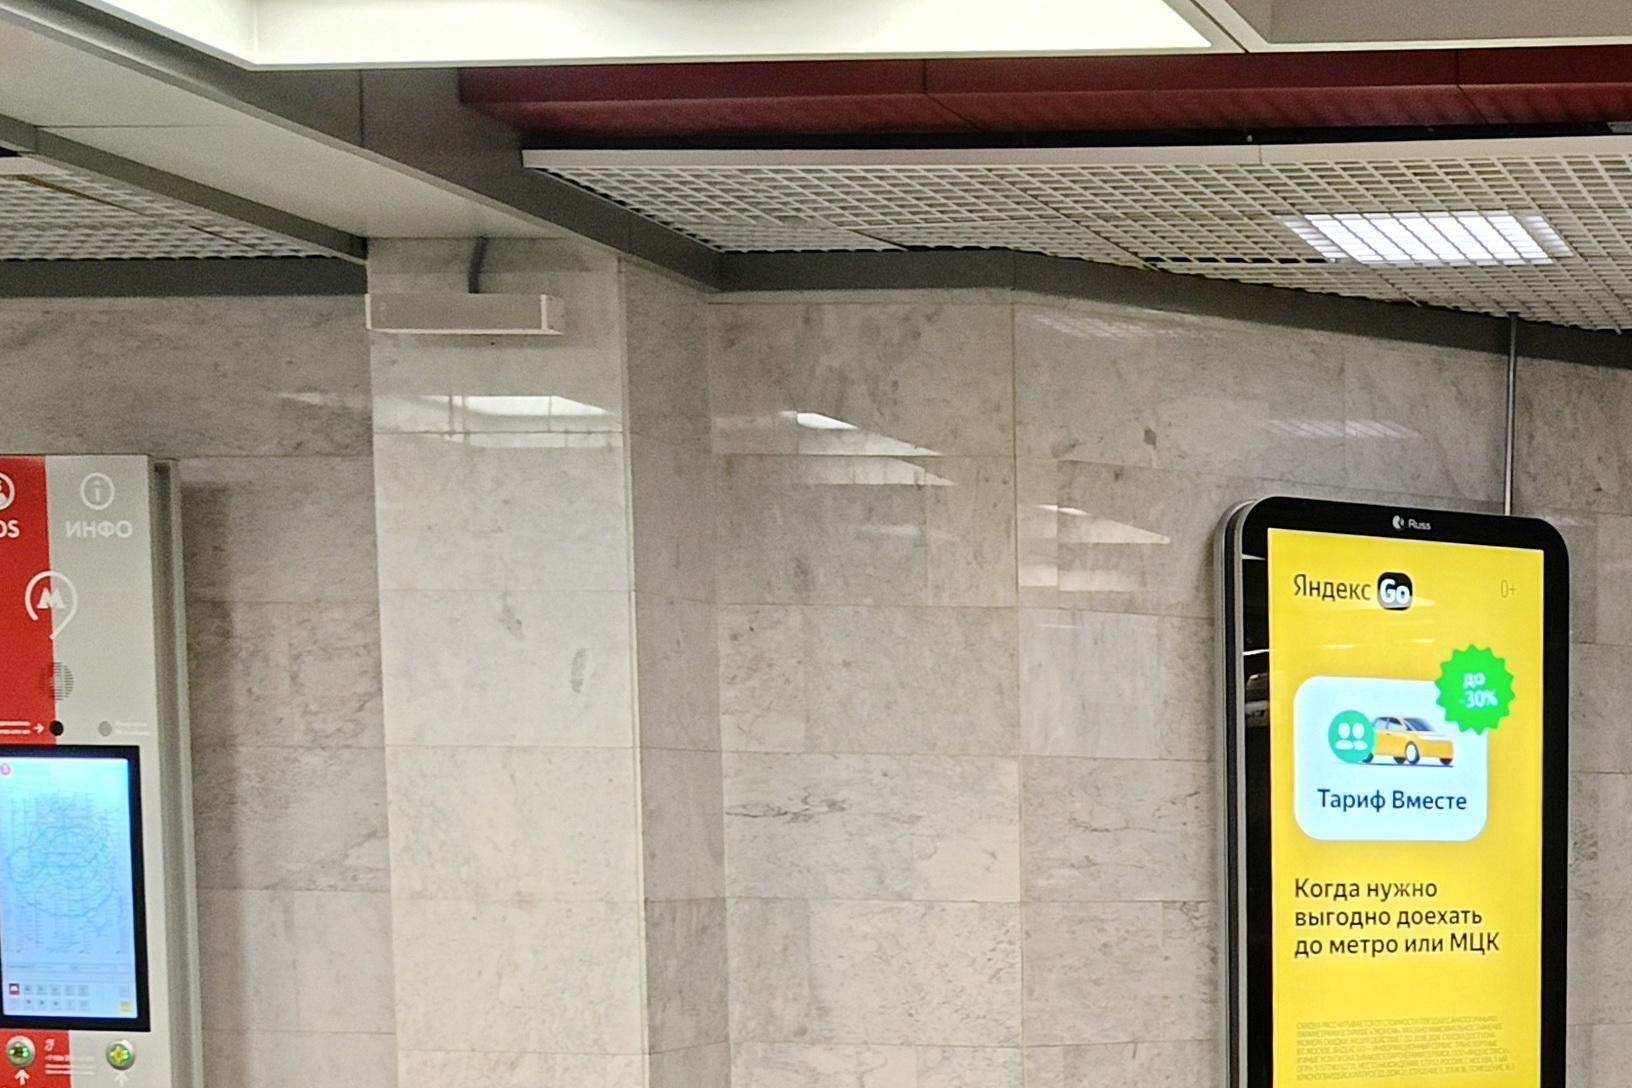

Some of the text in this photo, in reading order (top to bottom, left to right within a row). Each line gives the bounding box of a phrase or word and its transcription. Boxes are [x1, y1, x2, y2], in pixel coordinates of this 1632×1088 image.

[65, 519, 133, 538] ИНФО
[1293, 574, 1411, 604] Яндекс Go
[1317, 788, 1467, 812] Тариф Вместе
[1294, 878, 1438, 902] Когда нужно
[1295, 909, 1483, 929] выгодно доехать
[1294, 932, 1500, 958] до метро или МЦК
